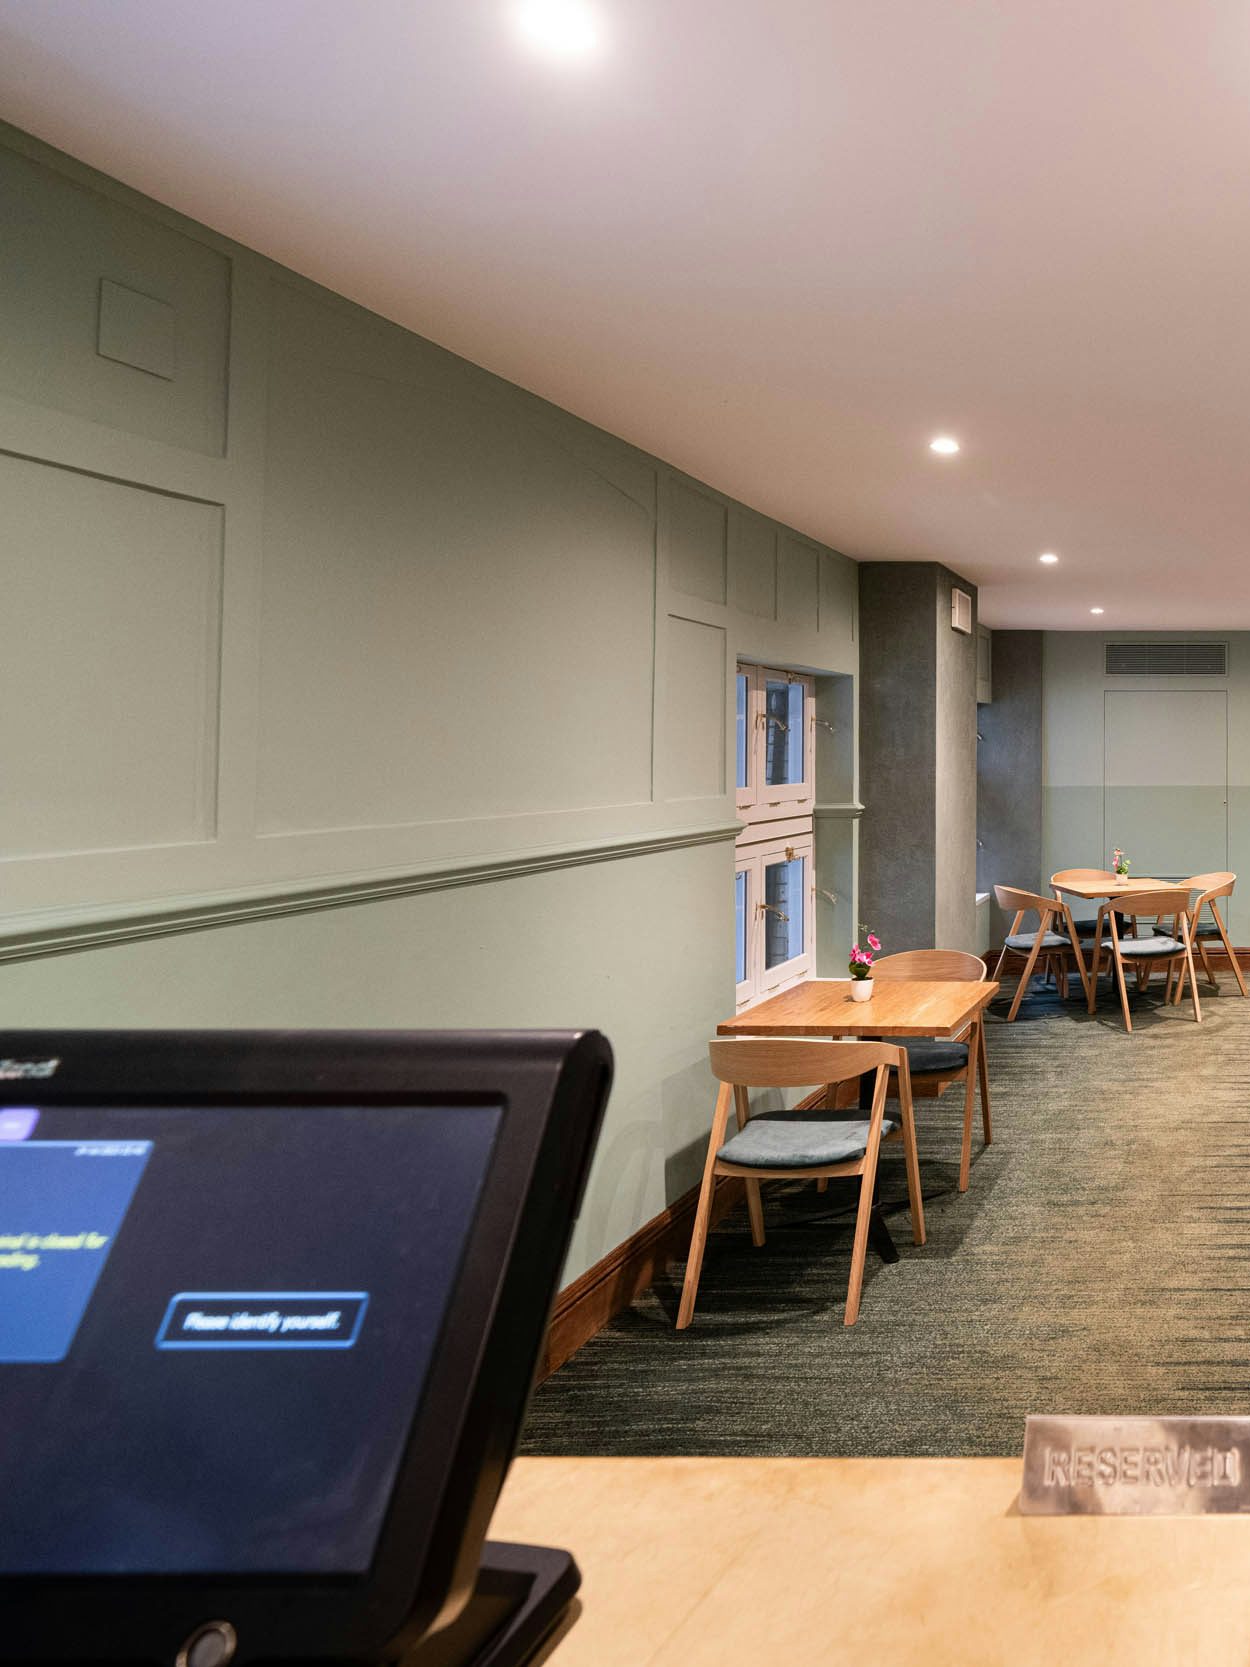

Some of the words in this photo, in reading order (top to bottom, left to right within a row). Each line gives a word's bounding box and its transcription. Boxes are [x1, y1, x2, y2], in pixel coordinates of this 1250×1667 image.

[85, 1231, 110, 1250] for
[183, 1311, 231, 1331] Please
[228, 1311, 281, 1334] identify
[1043, 1445, 1241, 1488] RESERVED
